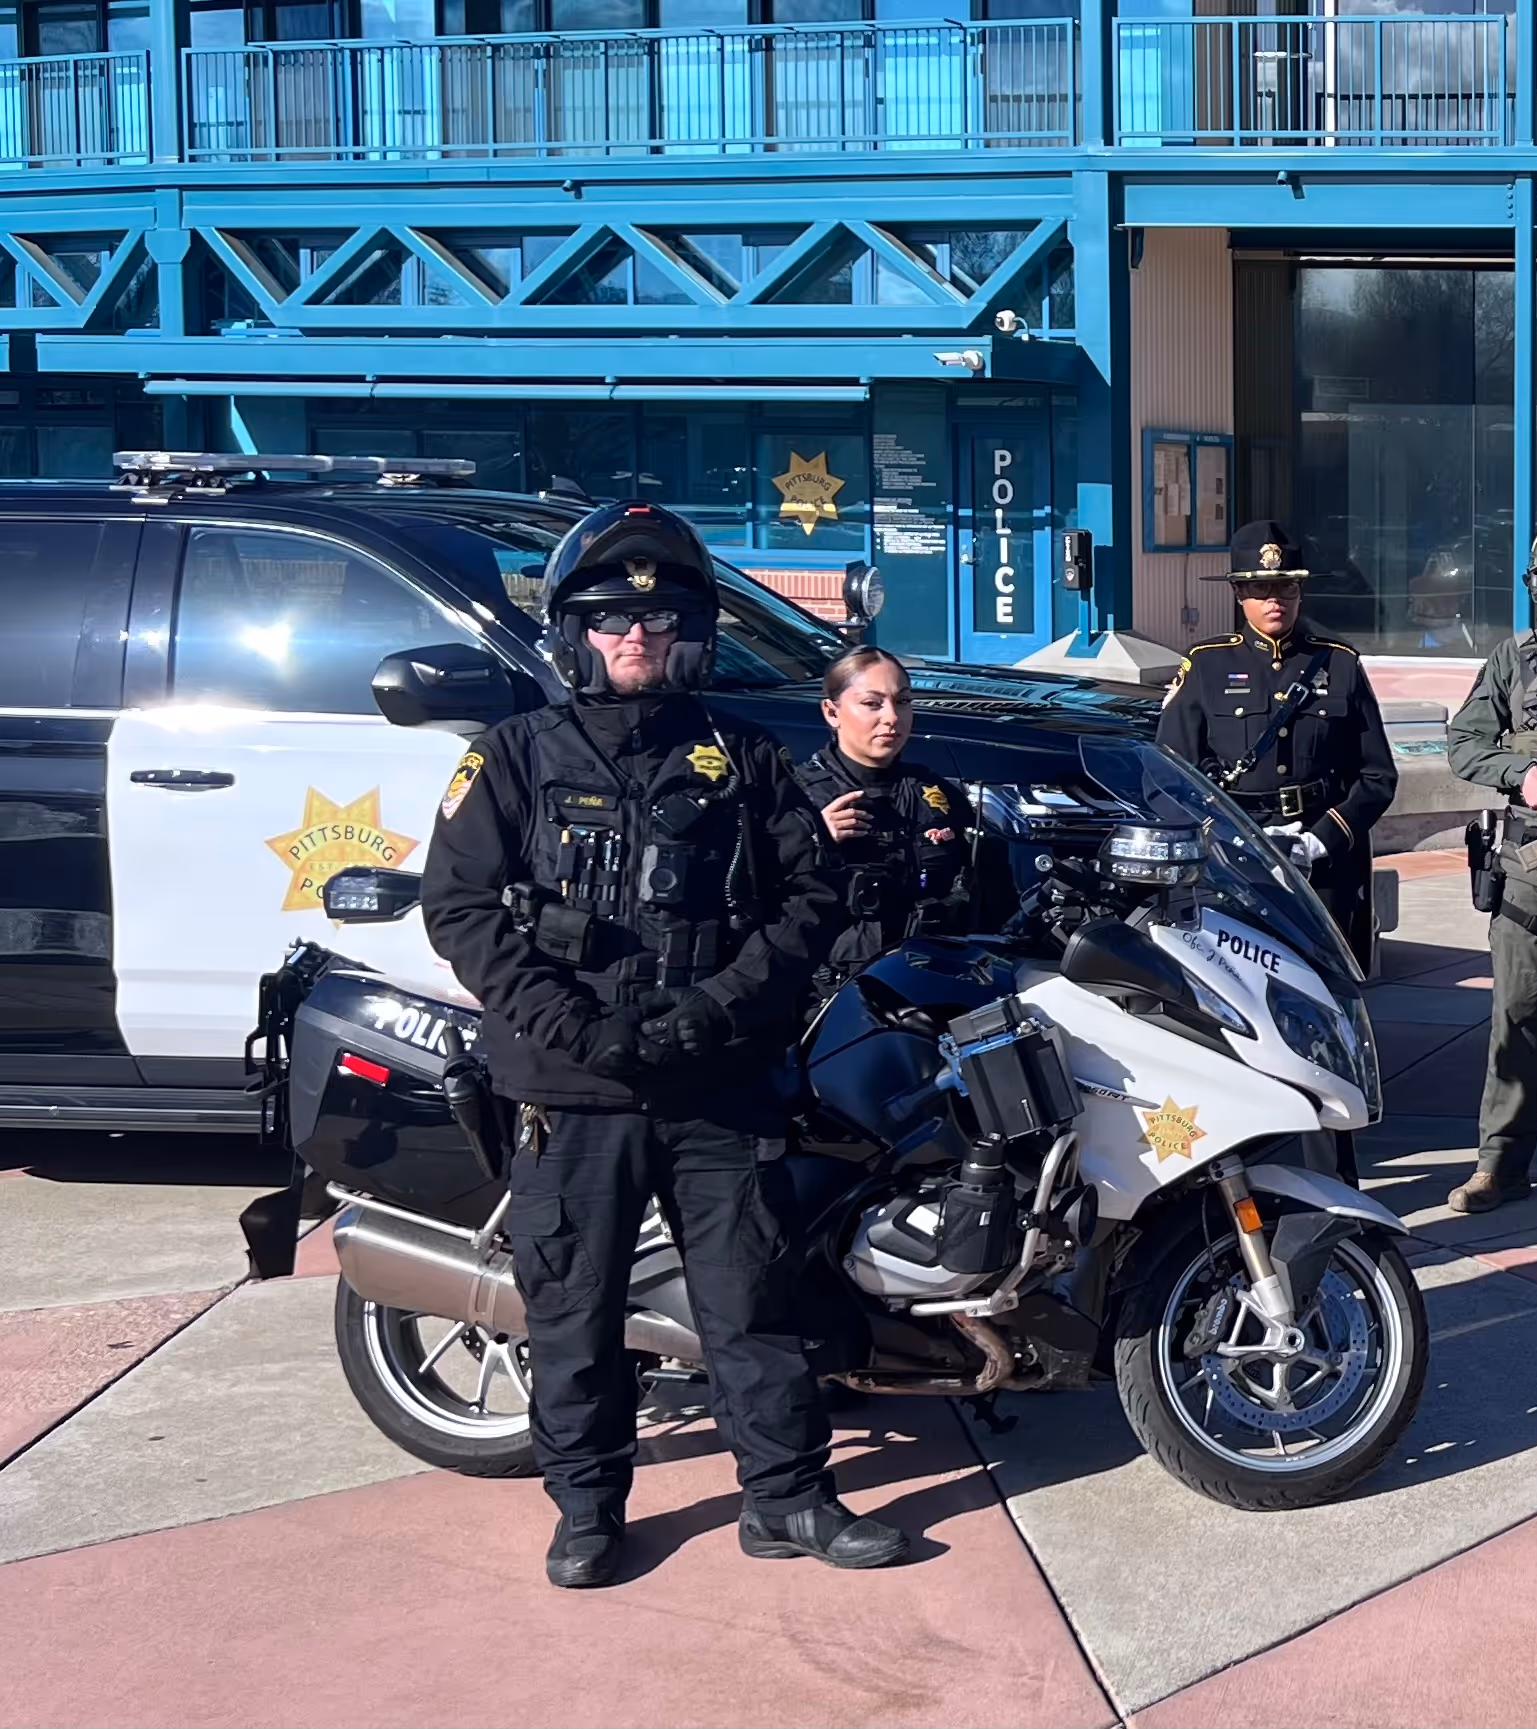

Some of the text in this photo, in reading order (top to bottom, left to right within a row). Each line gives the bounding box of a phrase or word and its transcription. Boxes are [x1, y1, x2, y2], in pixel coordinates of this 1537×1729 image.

[785, 472, 832, 492] PITTSBURG
[992, 449, 1015, 623] POLICE
[289, 825, 397, 861] PITTSBURG
[1217, 928, 1281, 974] POLICE
[1148, 1132, 1187, 1150] POLICE
[1150, 1113, 1197, 1138] PITTSBURG
[1208, 1298, 1228, 1336] brembo
